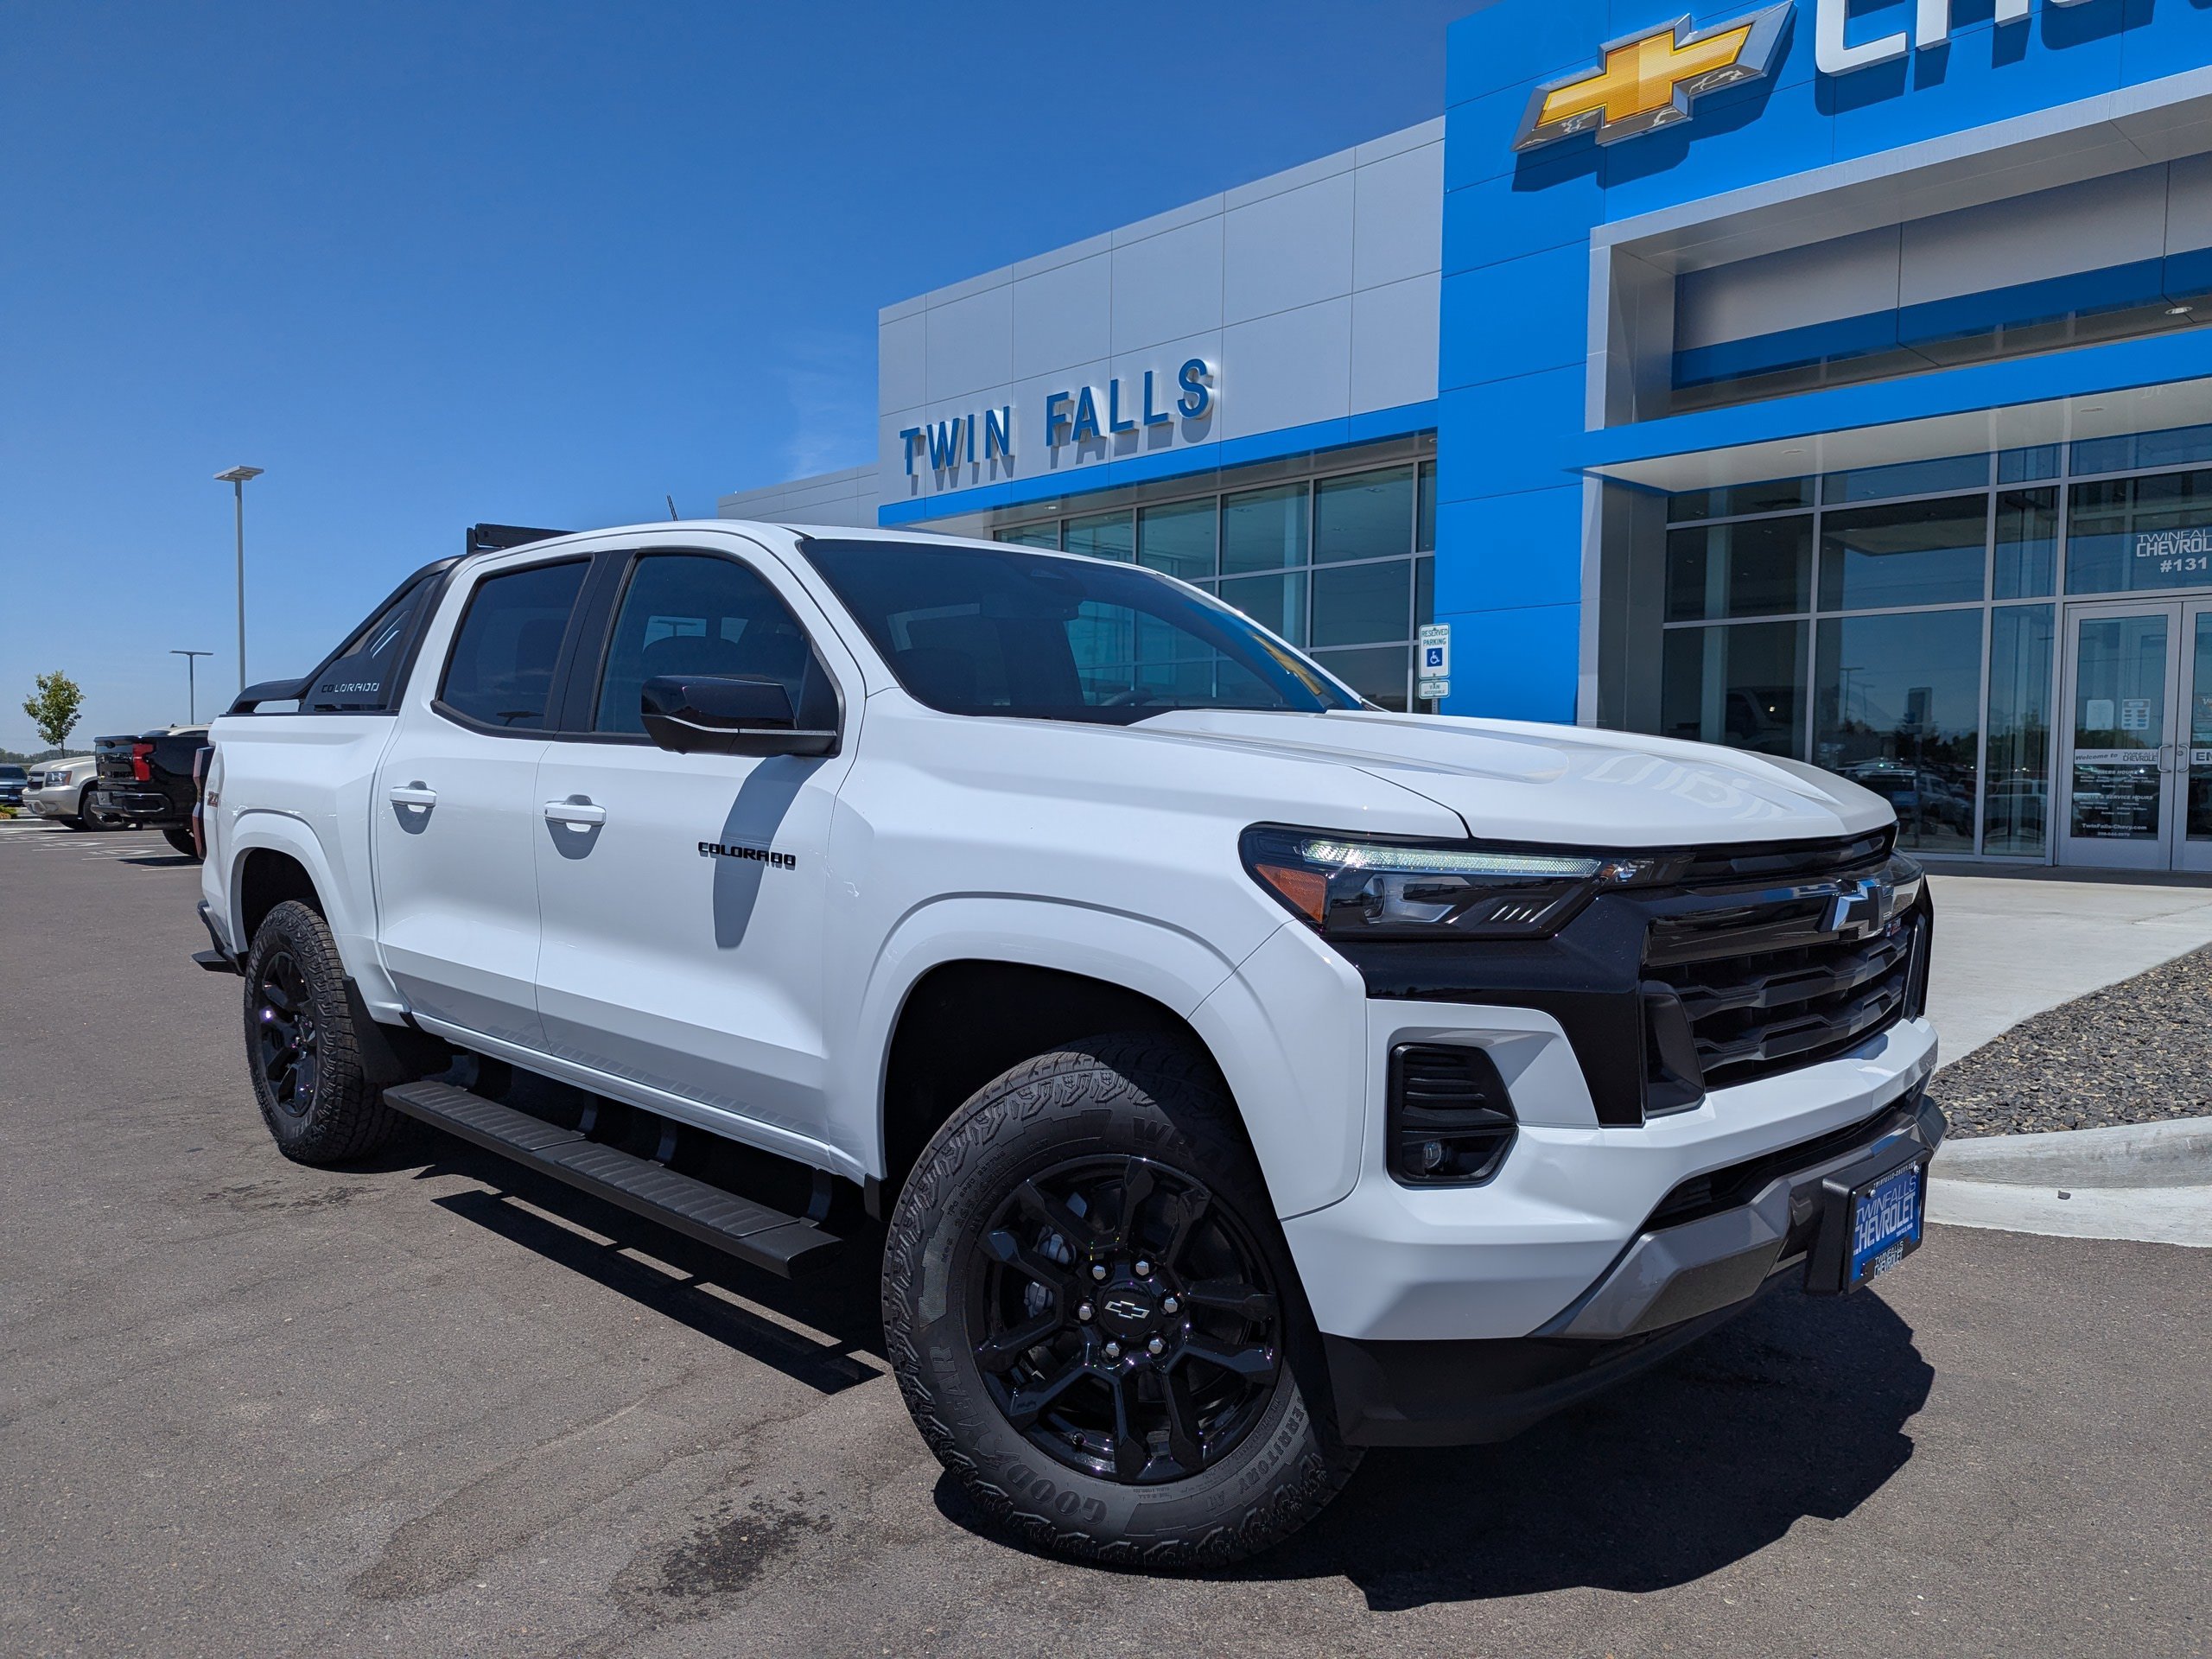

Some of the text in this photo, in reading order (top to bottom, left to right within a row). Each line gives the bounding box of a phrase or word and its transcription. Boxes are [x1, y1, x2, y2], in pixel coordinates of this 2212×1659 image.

[899, 358, 1211, 475] TWIN FALLS
[2160, 556, 2207, 573] #131
[1421, 628, 1448, 638] RESERVED
[1422, 638, 1446, 646] PARKING
[321, 683, 380, 693] COLORADO
[697, 842, 797, 866] COLORADO
[1856, 1175, 1916, 1226] TWINFALLS
[1874, 1250, 1903, 1279] CHEVROLET
[1875, 1240, 1904, 1265] TWINFALLS
